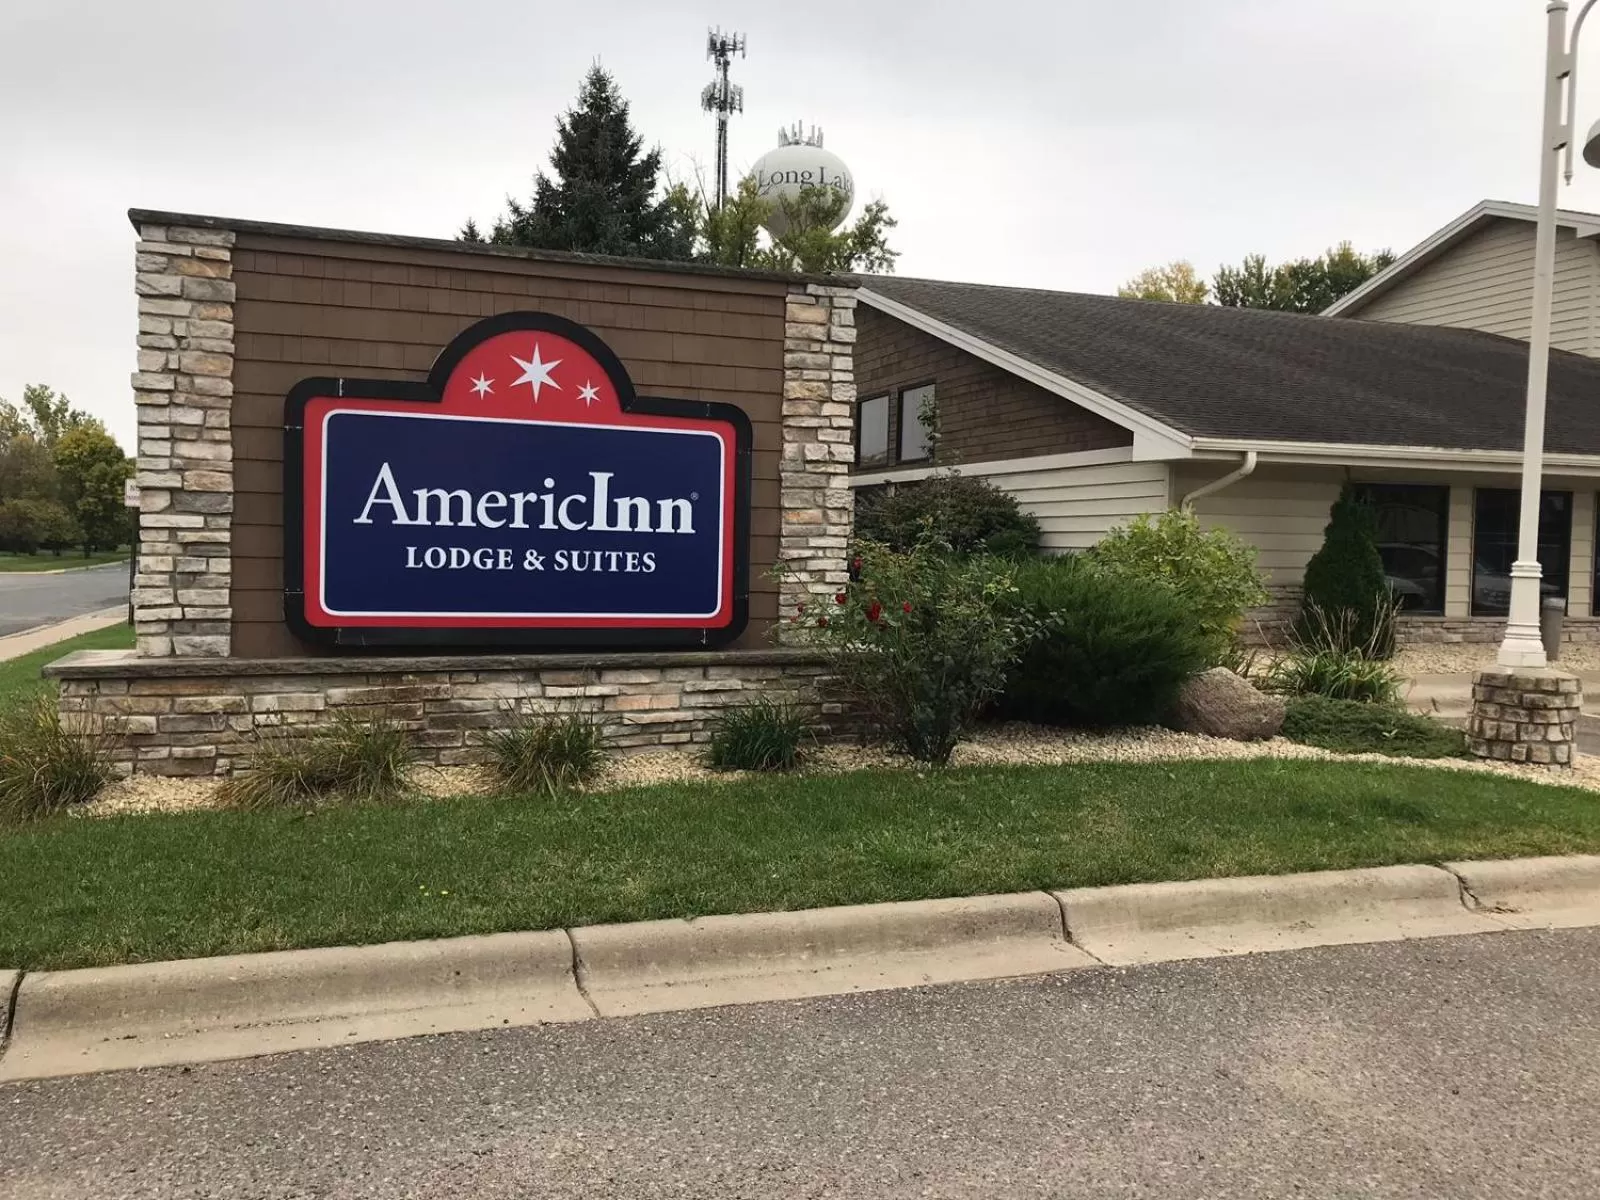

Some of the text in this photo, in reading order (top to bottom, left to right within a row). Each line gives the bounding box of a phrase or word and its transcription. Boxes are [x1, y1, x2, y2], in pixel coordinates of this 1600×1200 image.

[757, 170, 815, 191] Long
[406, 546, 656, 573] LODGE & SUITES
